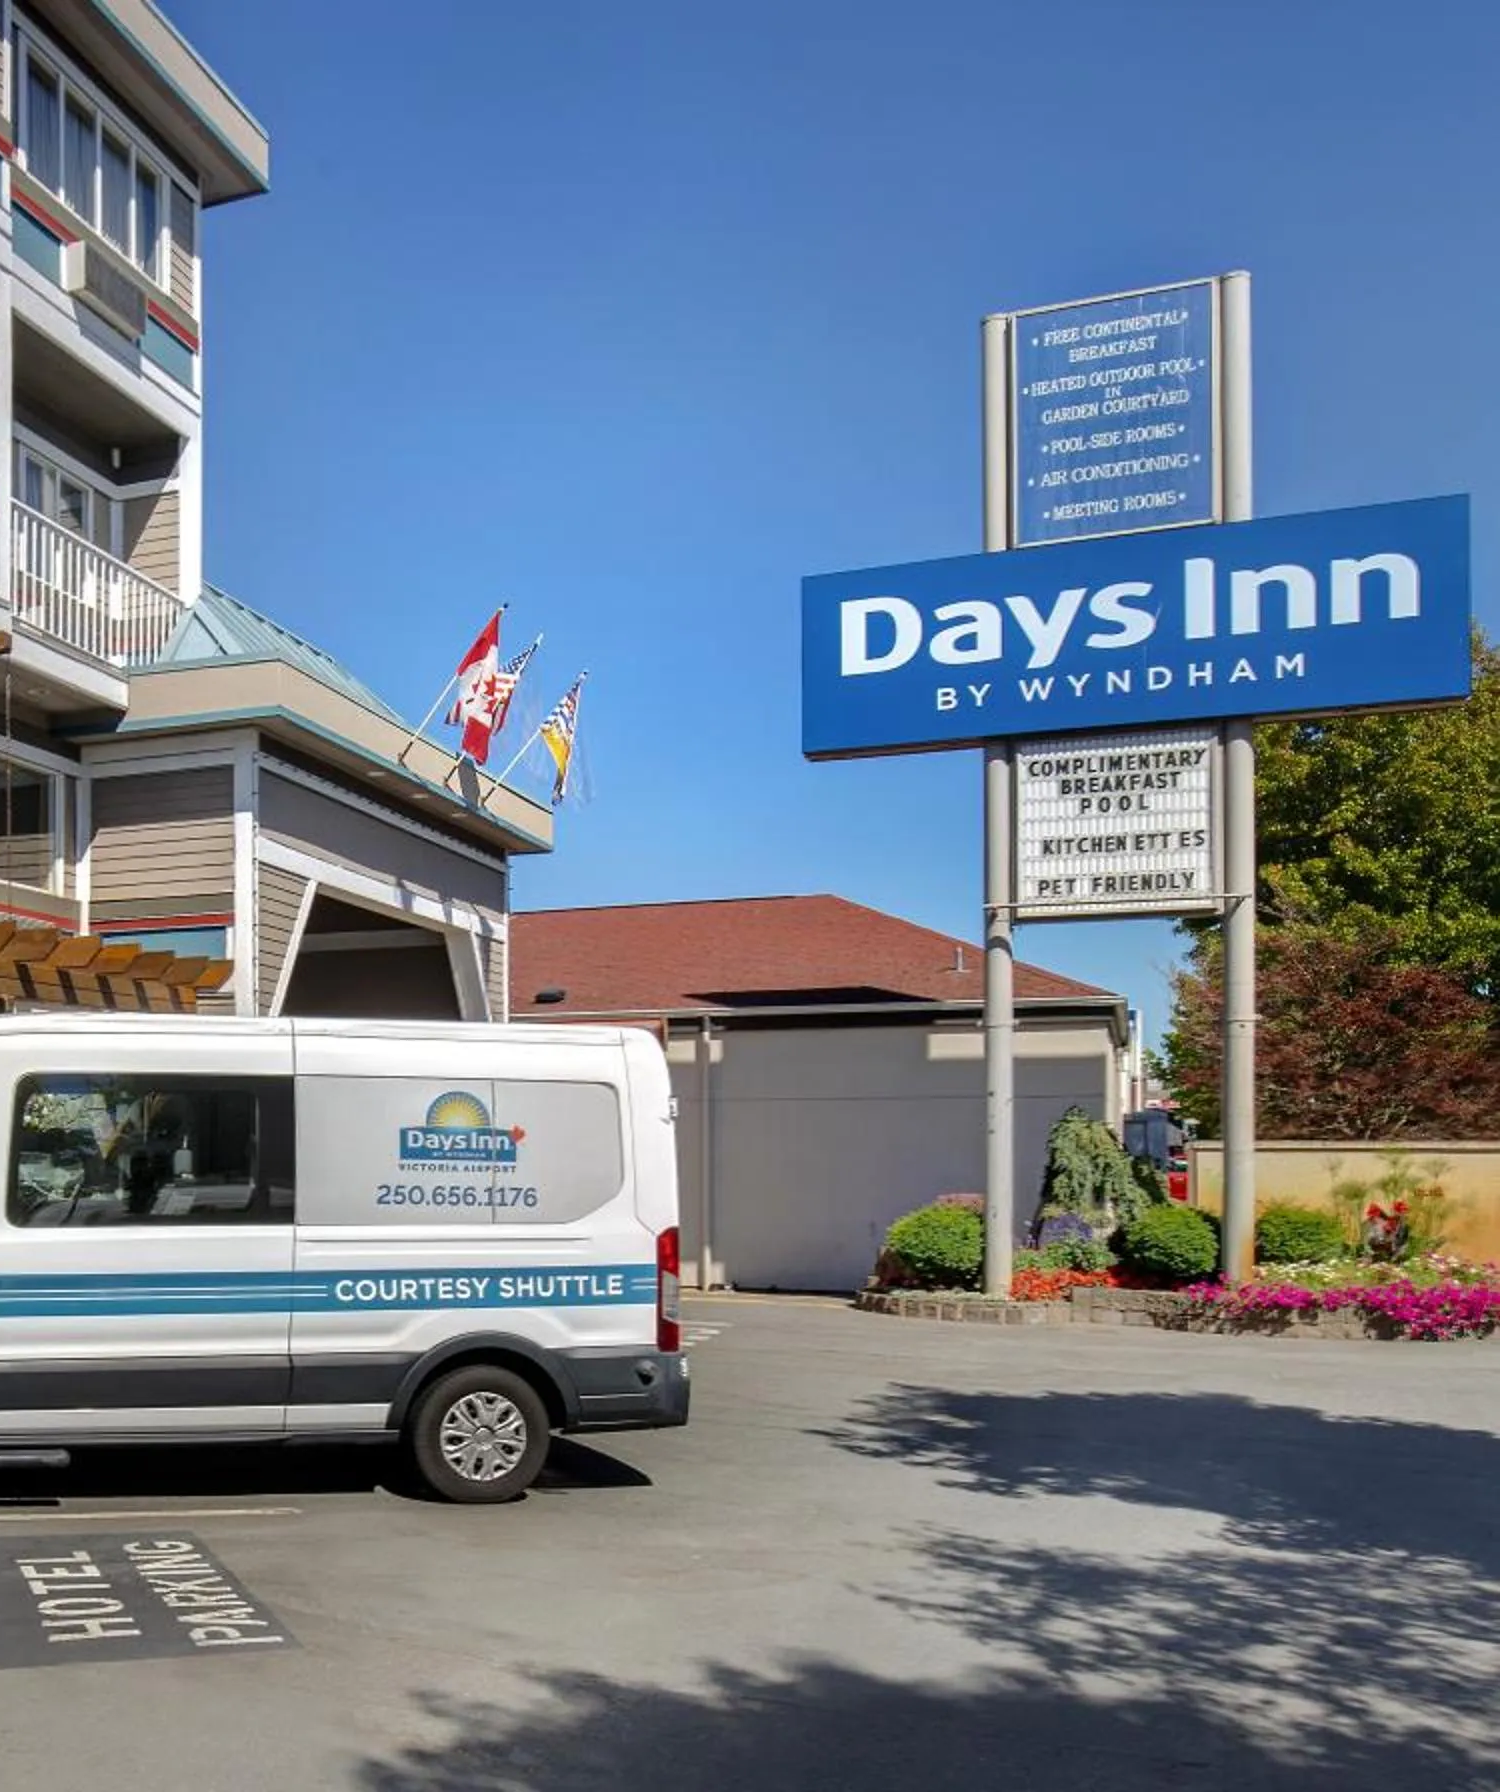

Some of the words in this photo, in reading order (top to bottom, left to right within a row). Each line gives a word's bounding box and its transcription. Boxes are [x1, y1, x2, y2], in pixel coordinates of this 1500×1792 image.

[1043, 328, 1081, 347] FREE
[1083, 311, 1182, 338] CONTINENTAL
[1069, 335, 1158, 363] BREAKFAST
[1031, 375, 1086, 397] HEATED
[1089, 363, 1157, 387] OUTDOOR
[1159, 358, 1197, 376] POOL
[1104, 385, 1122, 399] IN
[1042, 402, 1099, 425] GARDEN
[1102, 389, 1190, 416] COURTYARD
[1051, 432, 1123, 454] POOL-SIDE
[1125, 423, 1177, 444] ROOMS
[1041, 471, 1068, 488] AIR
[1071, 453, 1189, 483] CONDITIONING
[1052, 499, 1120, 521] MEETING
[1123, 490, 1177, 511] ROOMS
[839, 580, 1159, 677] Days
[1184, 552, 1422, 641] Inn
[936, 682, 993, 712] BY
[1020, 652, 1307, 703] WYNDHAM
[1028, 748, 1206, 777] COMPLIMENTARY
[1061, 771, 1181, 795] BREAKFAST
[1081, 794, 1150, 814] POOL
[1038, 877, 1077, 896] PET
[1092, 871, 1195, 893] FRIENDLY
[407, 1130, 466, 1151] Days
[469, 1132, 510, 1150] Inn
[398, 1163, 459, 1173] VICTORIA
[376, 1184, 538, 1208] 250.656.1176
[335, 1278, 490, 1301] COURTESY
[499, 1274, 624, 1297] SHUTTLE
[14, 1551, 142, 1642] HOTEL
[122, 1541, 284, 1647] PARKING
